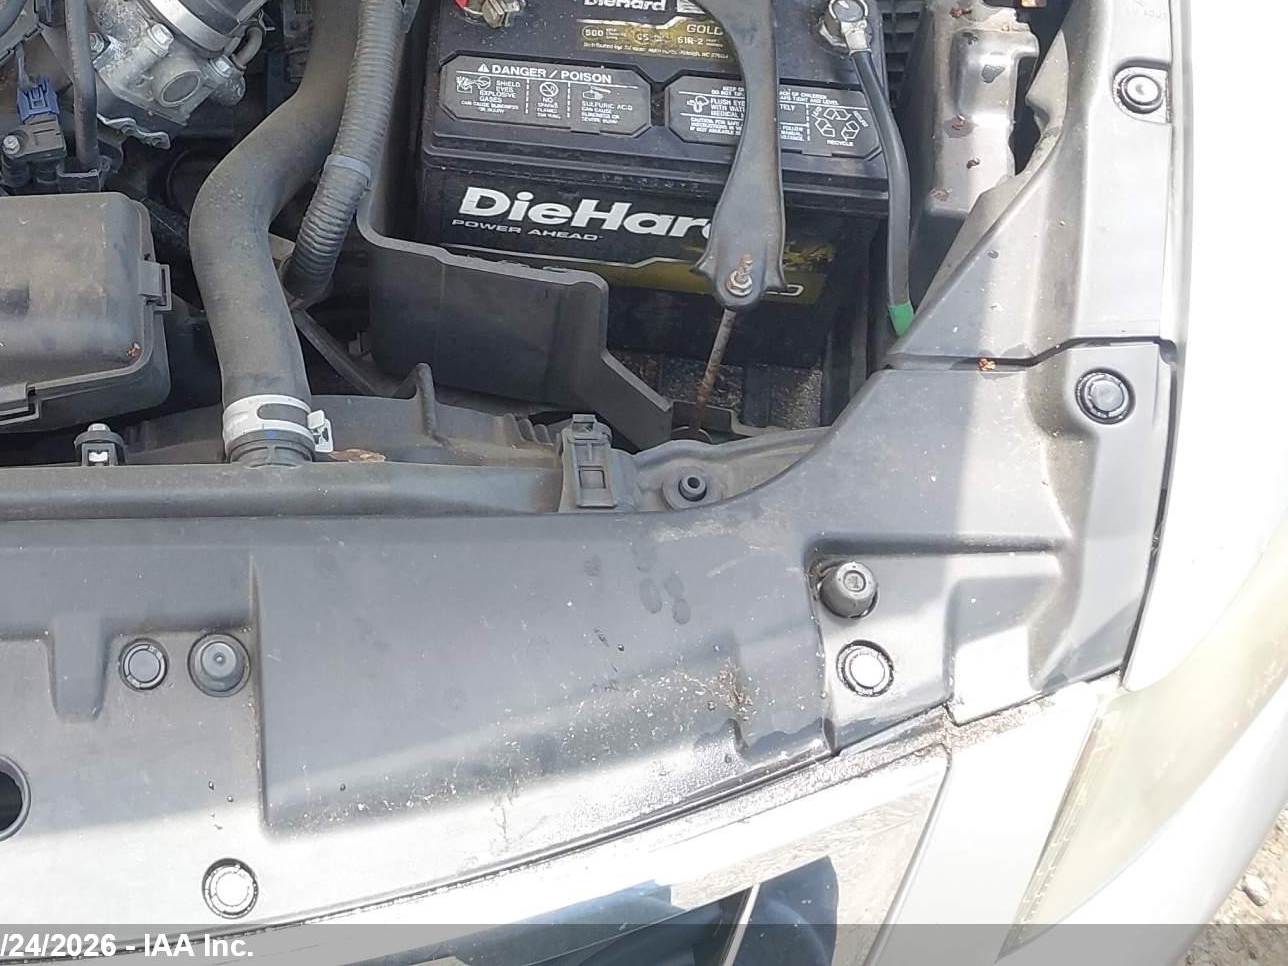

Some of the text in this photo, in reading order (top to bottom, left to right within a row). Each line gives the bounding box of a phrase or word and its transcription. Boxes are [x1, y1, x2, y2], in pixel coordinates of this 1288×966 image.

[686, 23, 724, 36] GOLD
[491, 63, 546, 78] DANGER
[561, 70, 612, 84] POISON
[495, 80, 521, 88] SHIELD
[479, 89, 517, 98] EXPLOSIVE
[479, 95, 503, 104] GASES
[711, 97, 731, 105] FLUSH
[581, 100, 615, 110] SULFURIC
[710, 110, 740, 118] MEDICAL
[826, 139, 854, 147] RECYCLE
[457, 186, 711, 238] DieHar
[451, 218, 599, 242] POWER AHEAD
